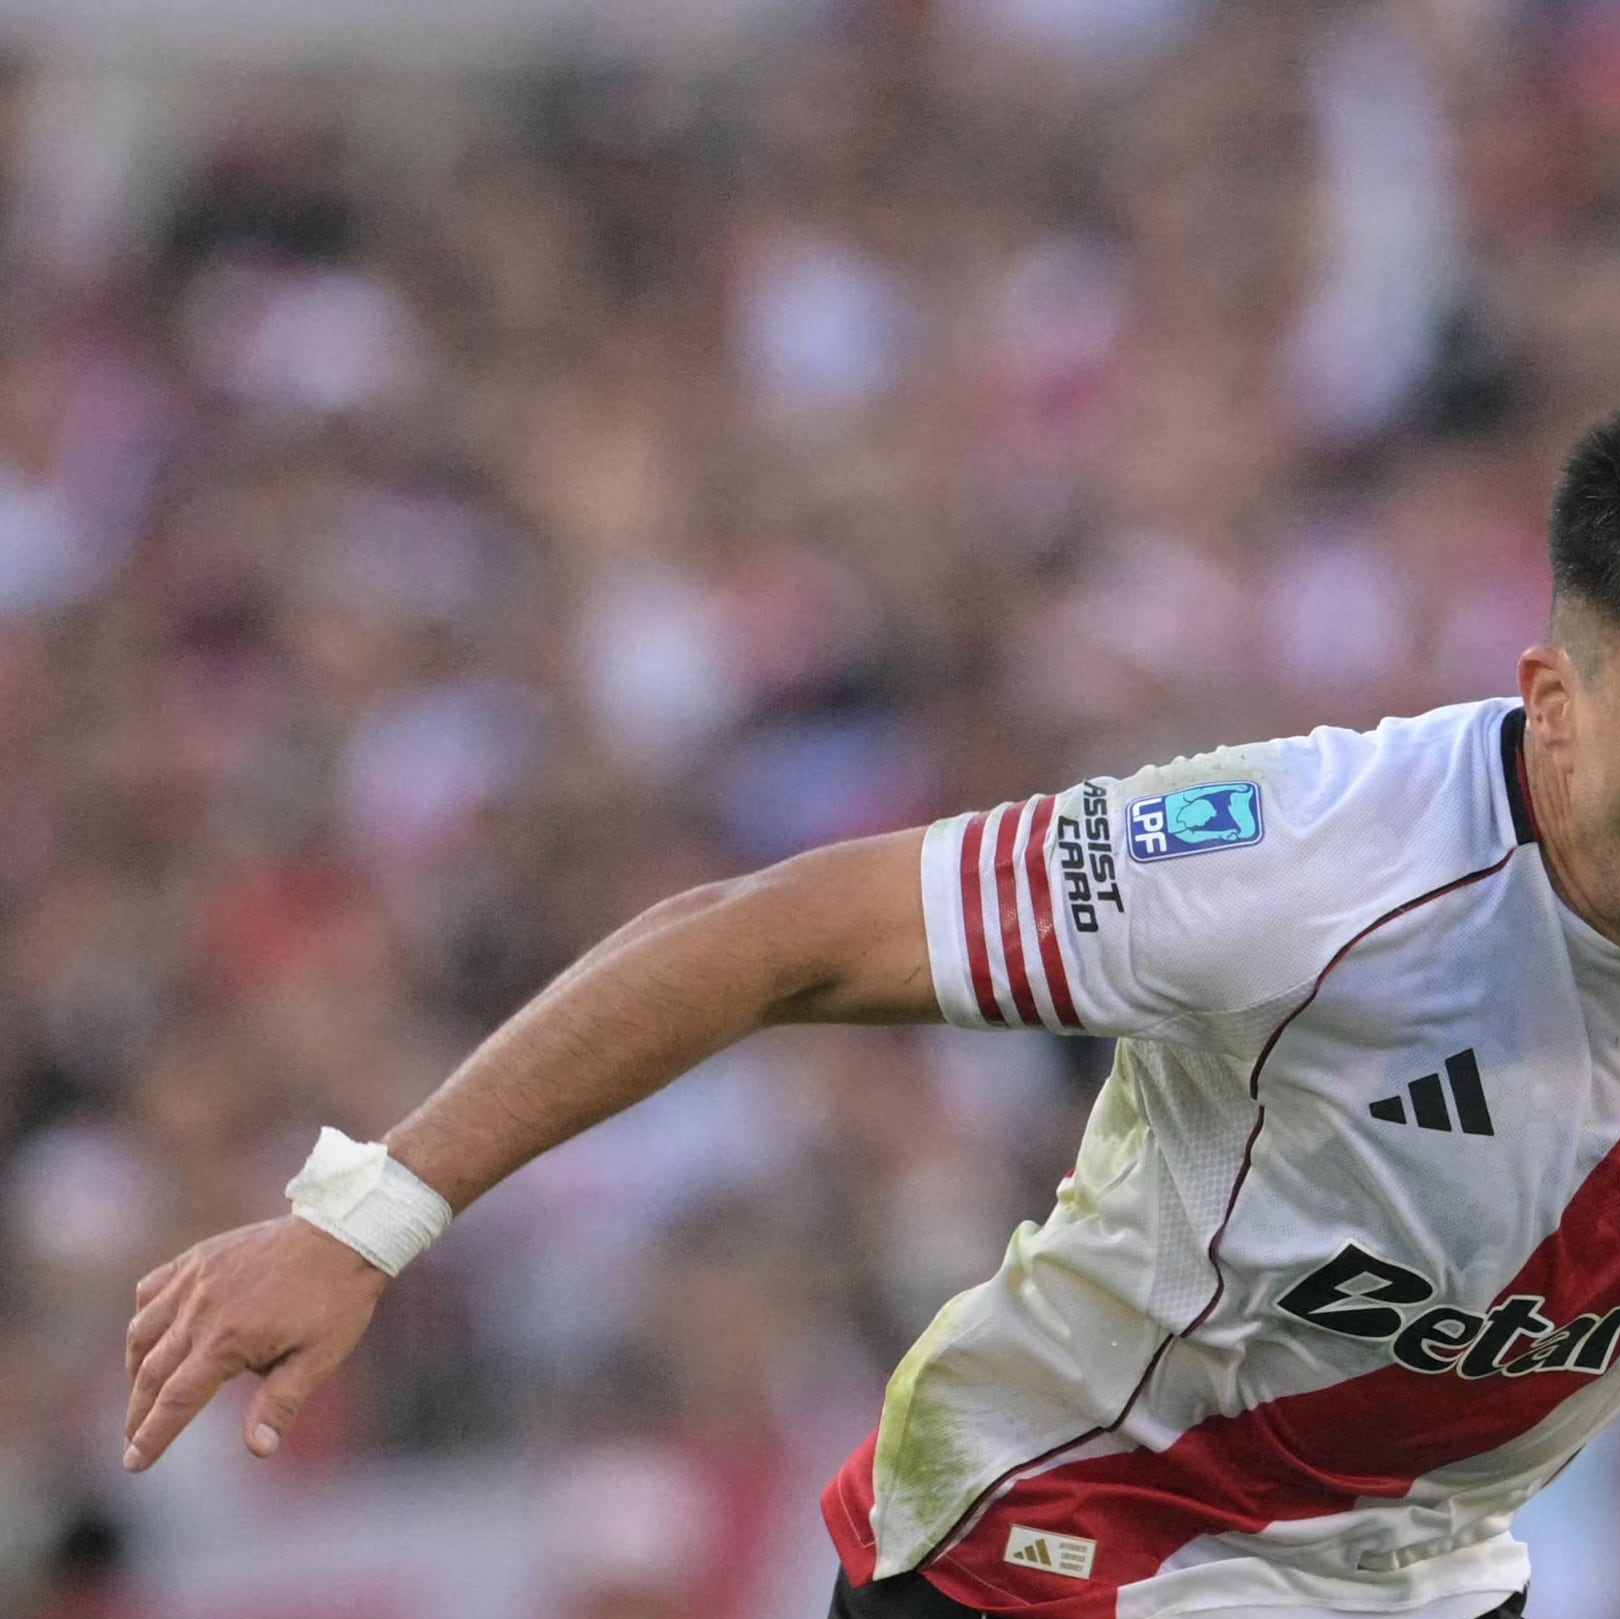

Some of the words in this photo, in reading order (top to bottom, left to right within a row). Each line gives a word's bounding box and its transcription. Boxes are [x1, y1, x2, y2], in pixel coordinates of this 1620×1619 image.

[1057, 815, 1099, 933] CARD
[1083, 780, 1125, 913] ASSIST
[1131, 797, 1168, 854] LPF
